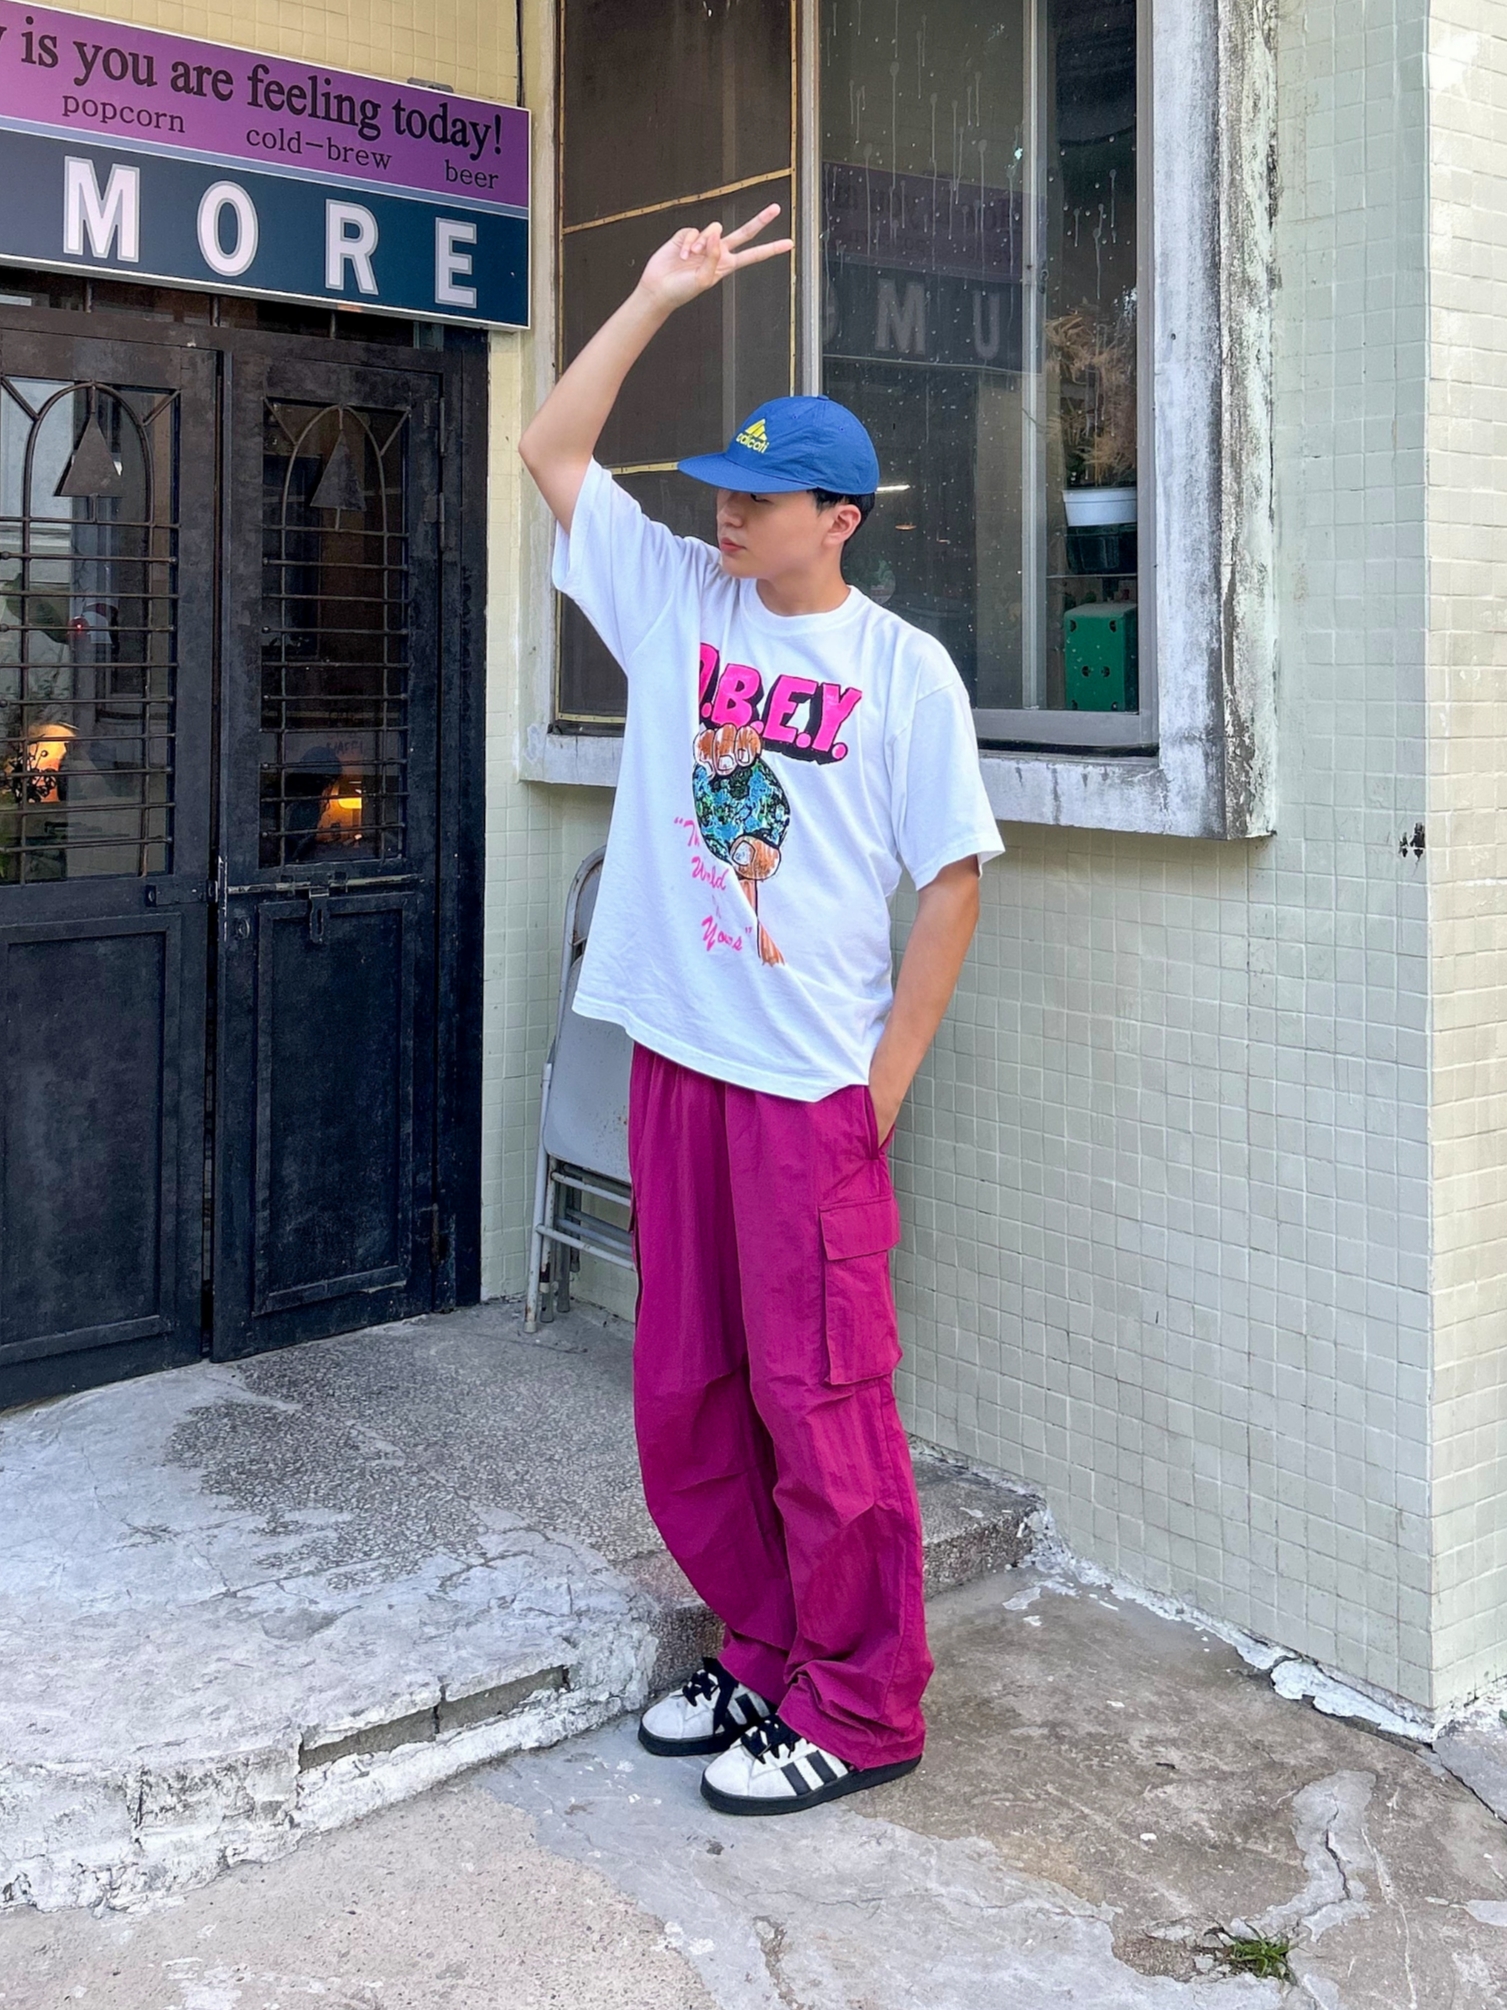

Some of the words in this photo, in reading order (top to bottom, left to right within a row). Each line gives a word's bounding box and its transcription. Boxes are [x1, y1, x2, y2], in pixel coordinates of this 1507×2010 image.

[20, 16, 59, 69] is
[73, 40, 157, 87] you
[170, 58, 234, 101] are
[247, 63, 381, 142] feeling
[393, 98, 502, 161] today!
[62, 95, 186, 134] popcorn
[246, 126, 392, 171] cold-brew
[444, 159, 499, 190] beer
[63, 155, 478, 310] MORE
